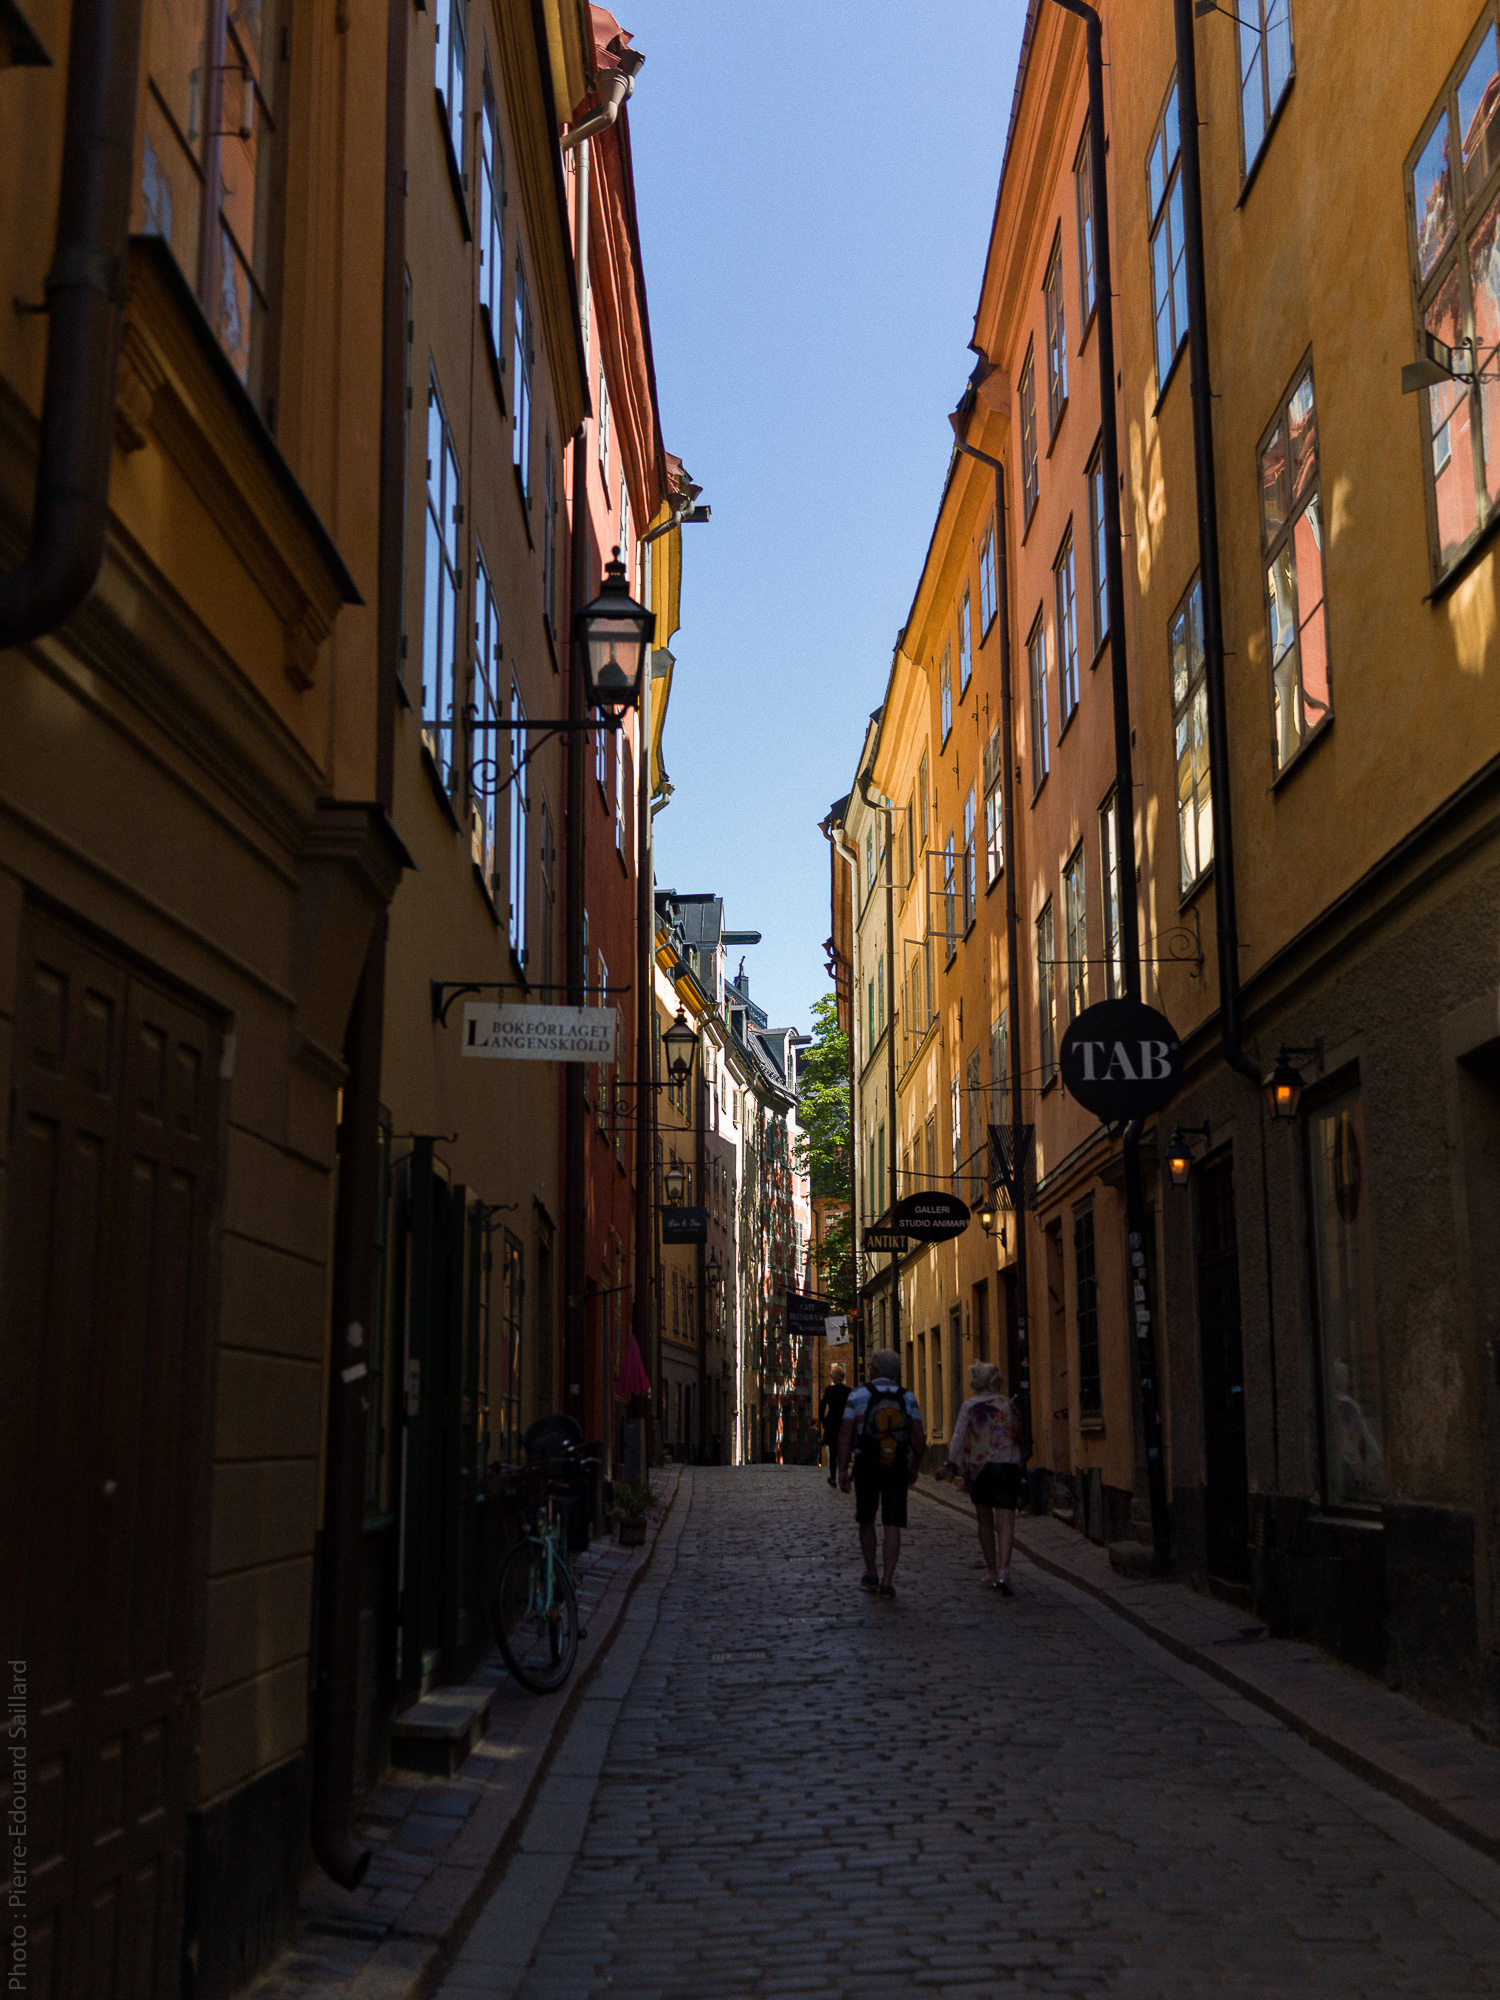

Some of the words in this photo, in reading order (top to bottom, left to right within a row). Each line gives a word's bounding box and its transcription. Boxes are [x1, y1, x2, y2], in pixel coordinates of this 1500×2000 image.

[492, 1021, 611, 1038] BOKFÖRLAGET
[1071, 1040, 1172, 1080] TAB
[914, 1205, 951, 1214] GALLERI
[899, 1219, 931, 1228] STUDIO
[932, 1219, 966, 1228] ANIMAR
[867, 1235, 906, 1248] ANTIKT
